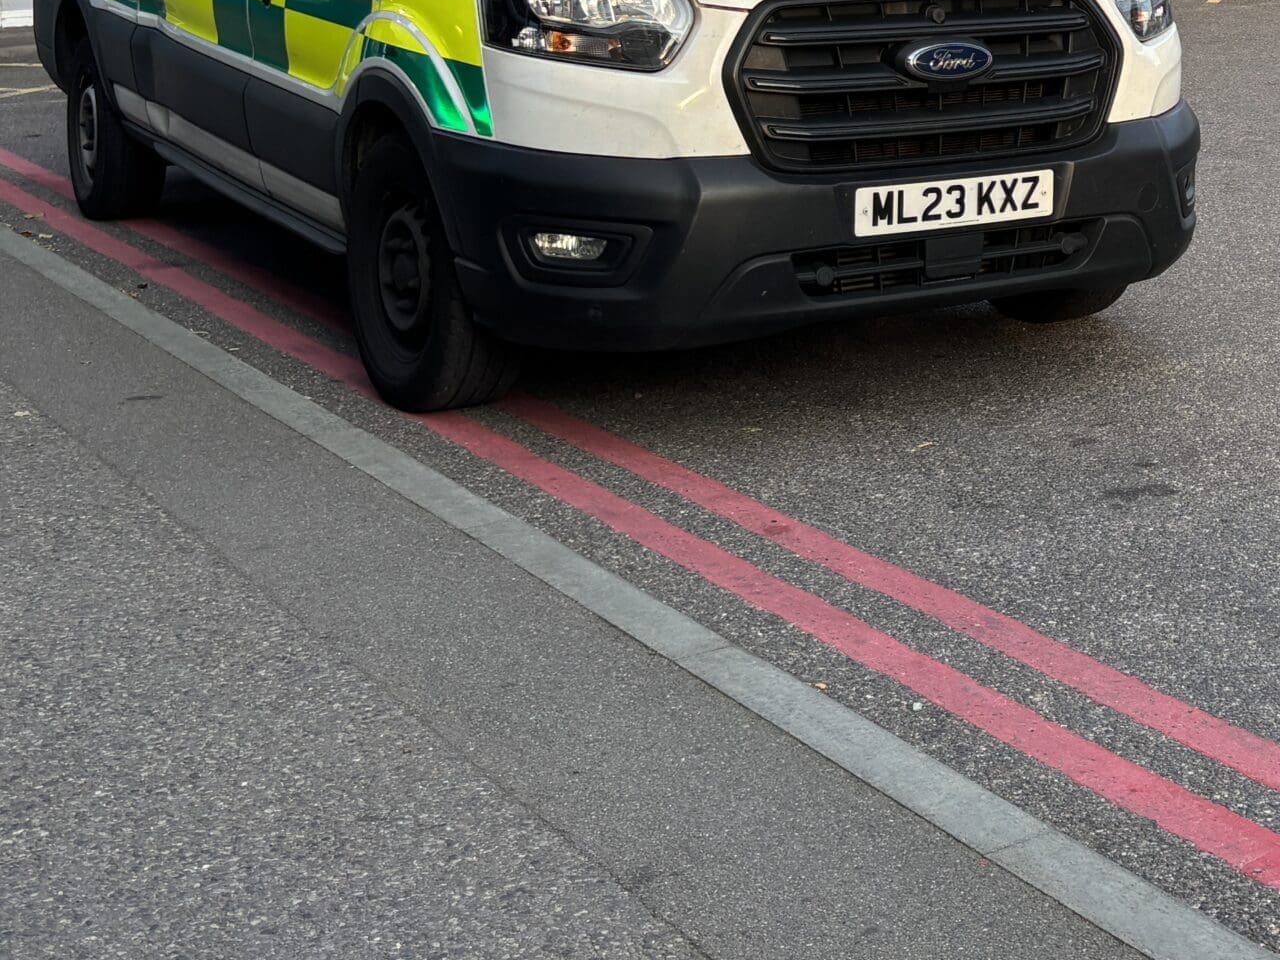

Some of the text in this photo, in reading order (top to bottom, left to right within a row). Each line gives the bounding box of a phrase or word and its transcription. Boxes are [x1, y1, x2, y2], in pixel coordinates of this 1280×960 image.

[929, 48, 976, 71] Ford
[871, 175, 1040, 227] ML23 KXZ
